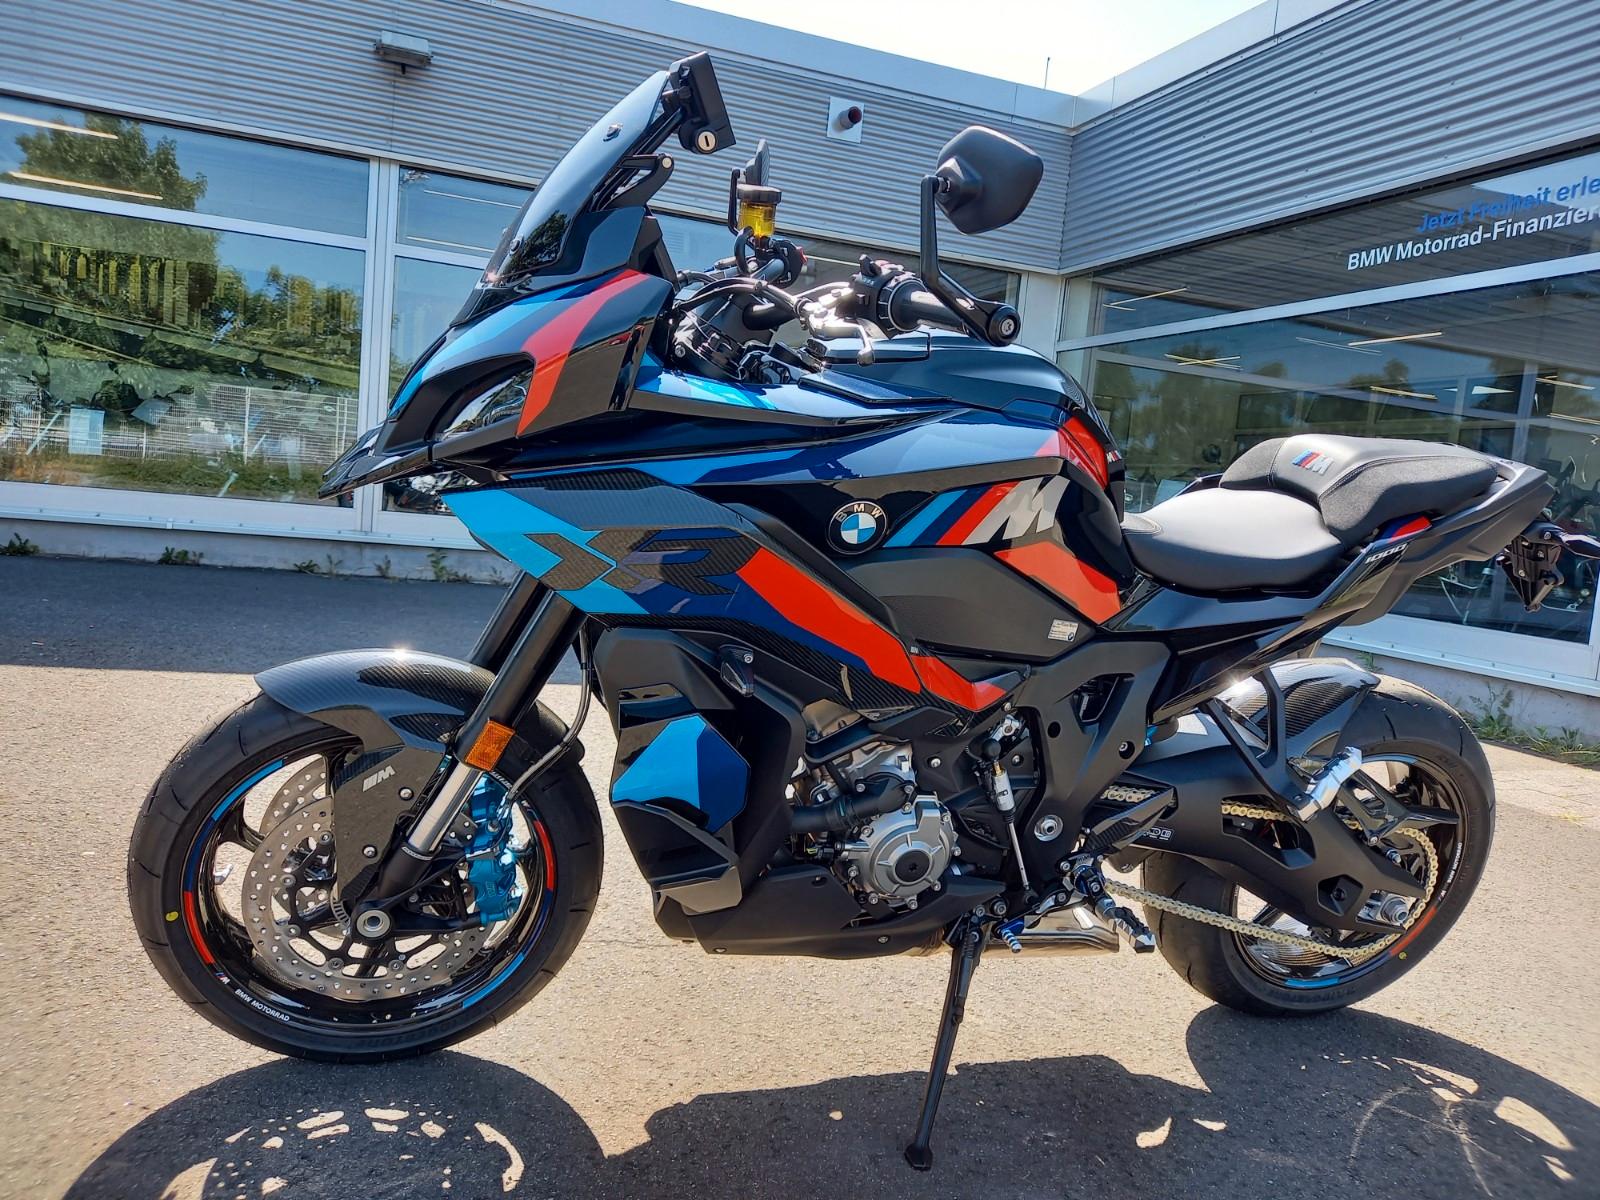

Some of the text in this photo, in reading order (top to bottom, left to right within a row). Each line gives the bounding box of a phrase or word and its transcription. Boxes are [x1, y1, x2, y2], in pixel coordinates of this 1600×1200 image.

[1417, 207, 1466, 234] Jetzt
[1468, 186, 1552, 223] Freiheit
[1347, 244, 1395, 271] BMW
[835, 503, 884, 523] BMW
[961, 474, 1070, 546] M
[1364, 542, 1409, 564] 1000
[235, 989, 252, 1002] BMW
[251, 1001, 290, 1021] MOTORRAD
